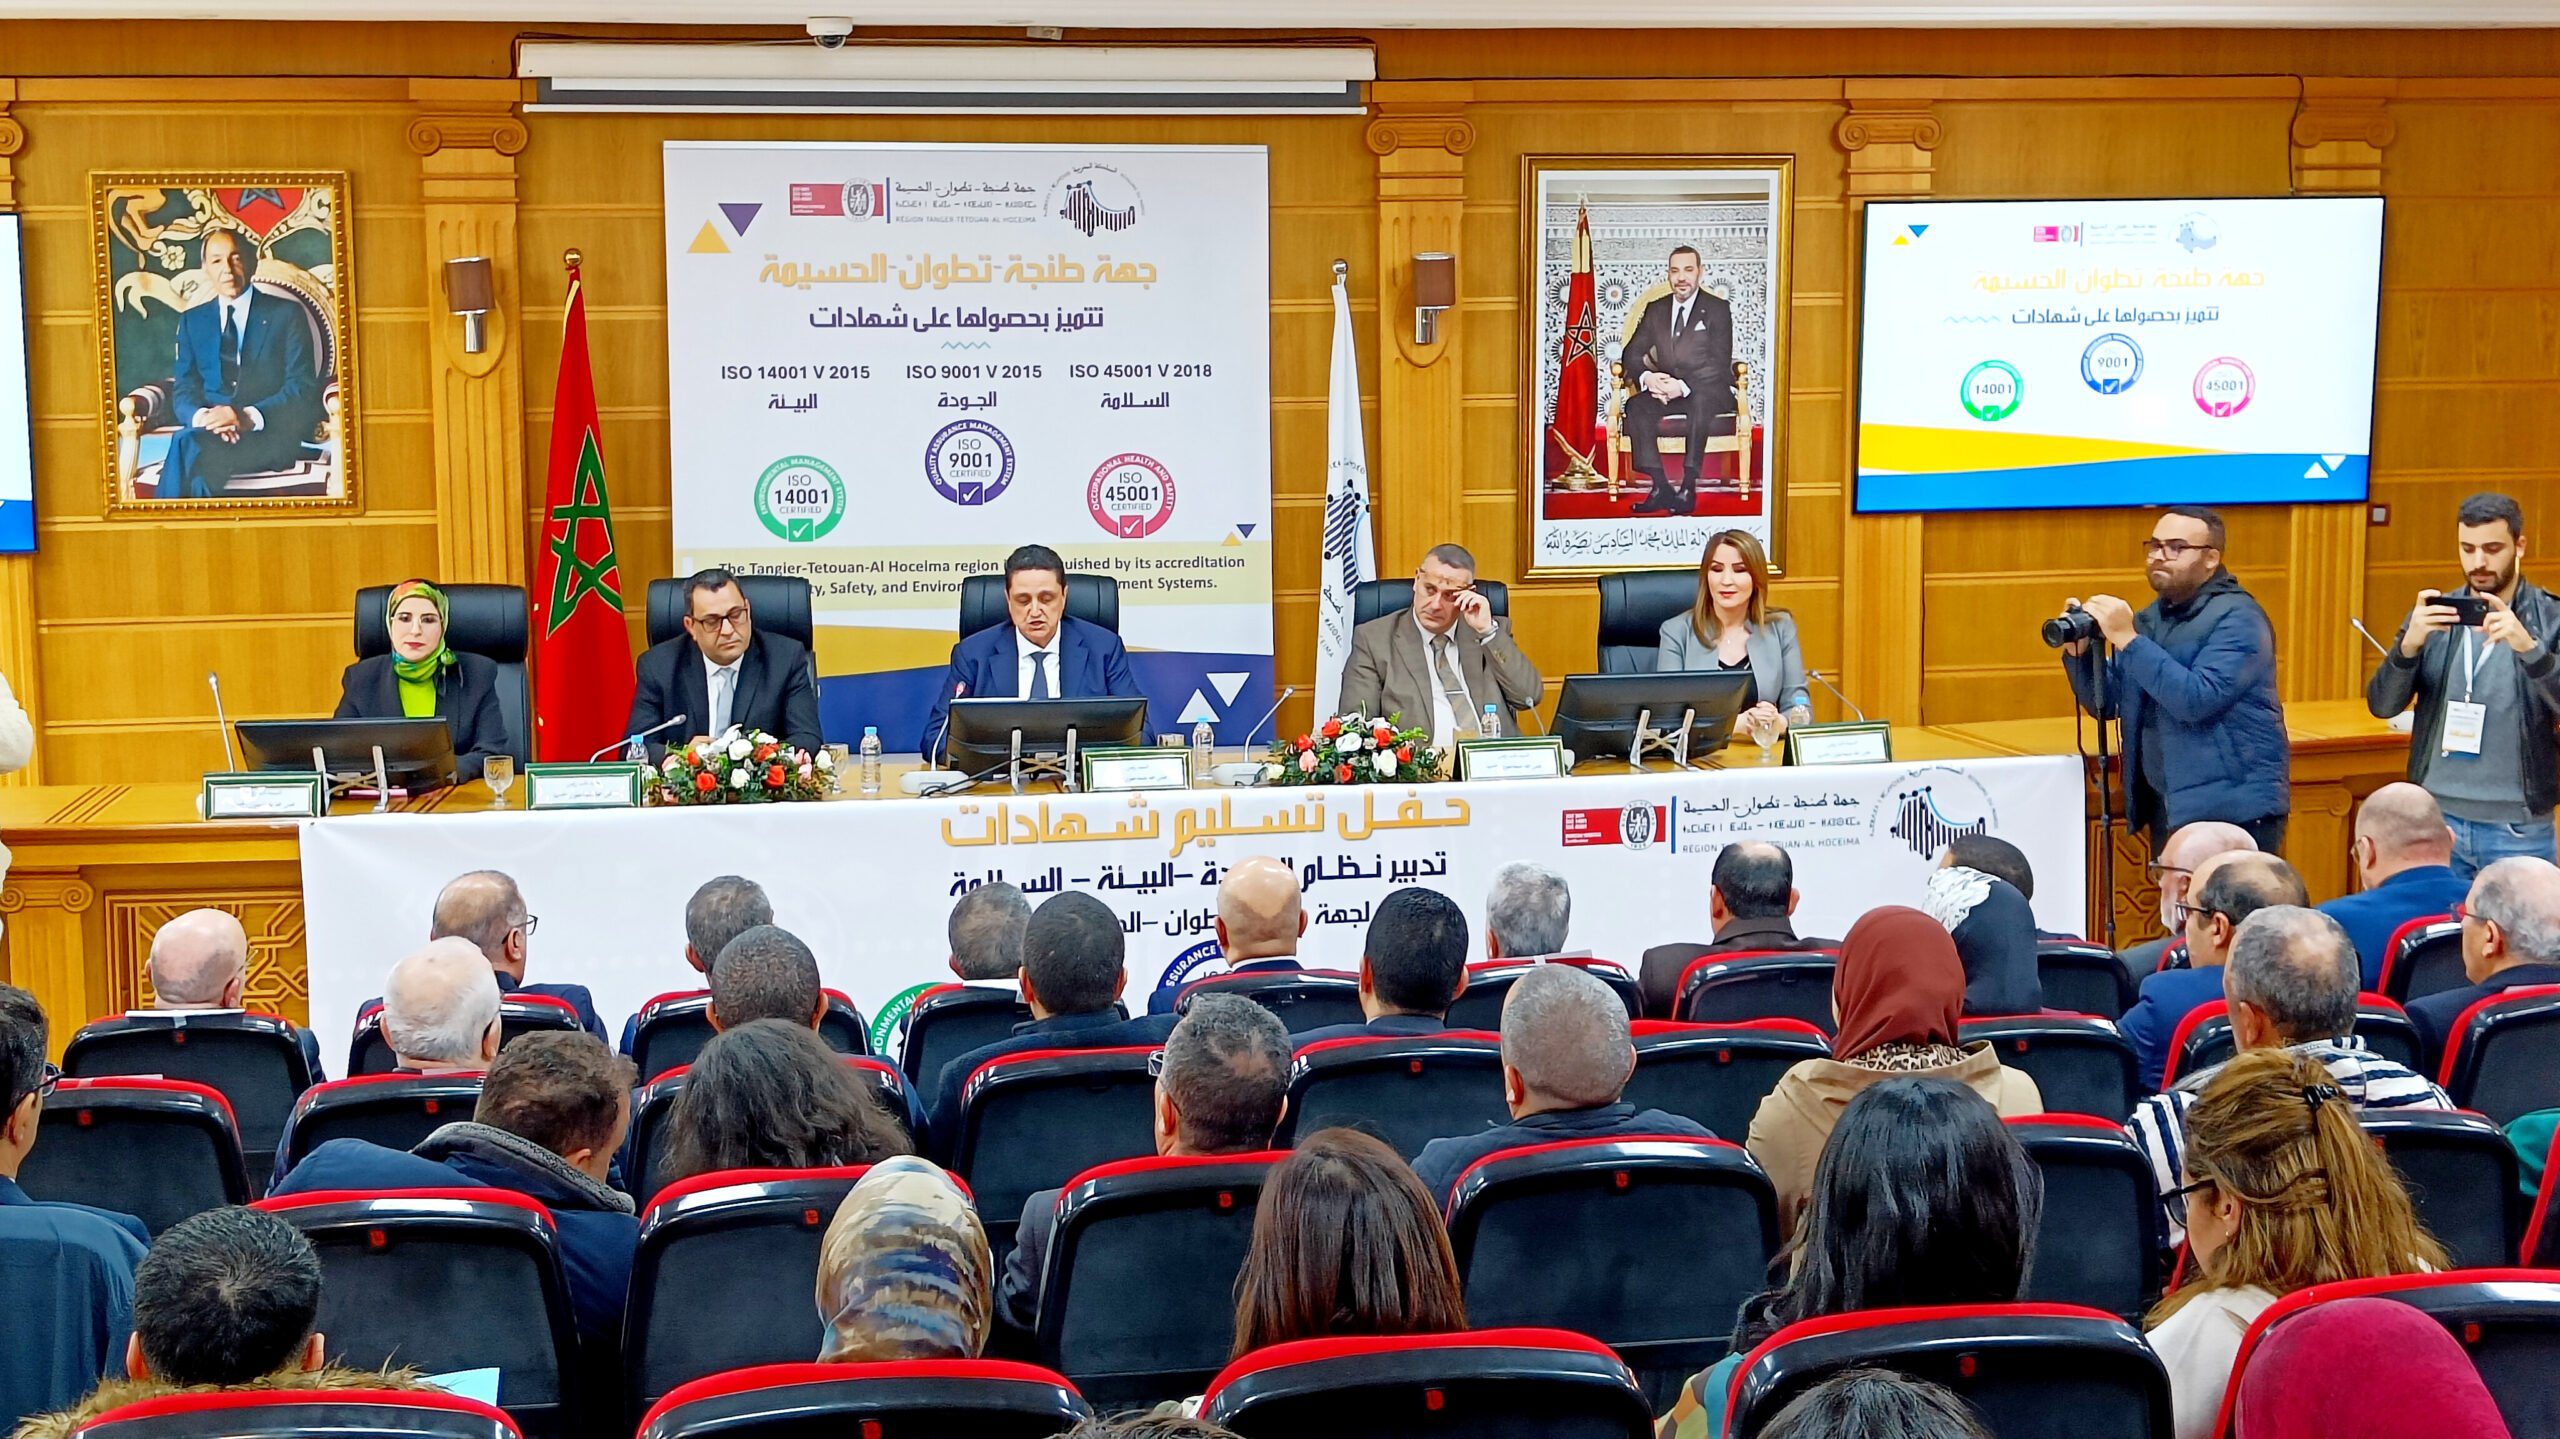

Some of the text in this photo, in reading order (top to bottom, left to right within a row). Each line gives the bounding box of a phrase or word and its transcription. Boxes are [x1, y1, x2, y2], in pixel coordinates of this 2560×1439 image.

[1092, 253, 1157, 290] جهة
[809, 303, 1104, 332] تتميز بحصولها على شهادات
[906, 364, 1042, 379] ISO 9001 V 2015
[1069, 363, 1212, 378] ISO 45001 V 2018
[2097, 357, 2129, 369] 9001
[721, 365, 871, 380] ISO 14001 V 2015
[1975, 383, 2013, 395] 14001
[2205, 379, 2244, 392] 45001
[768, 393, 818, 413] البيئة
[937, 391, 997, 411] الجودة
[1100, 391, 1169, 410] السلامة
[958, 438, 982, 450] ISO
[949, 452, 992, 468] 9001
[787, 474, 812, 486] ISO
[1119, 472, 1143, 484] ISO
[774, 488, 828, 505] 14001
[1105, 486, 1158, 501] 45001
[719, 563, 745, 575] The
[749, 560, 884, 575] Tangier-Tetouan-Al
[955, 558, 999, 574] region
[1114, 557, 1130, 575] by
[1135, 556, 1151, 569] its
[1155, 555, 1245, 569] accreditation
[830, 580, 877, 595] Safety,
[882, 581, 908, 593] and
[1158, 577, 1218, 593] Systems.
[941, 788, 1470, 858] حفل تسليم شهادات
[1300, 854, 1382, 893] نظام
[1389, 851, 1447, 883] تدبير
[1164, 909, 1219, 937] طوان
[1314, 900, 1370, 929] لجهة
[1165, 944, 1217, 988] SSURANCE
